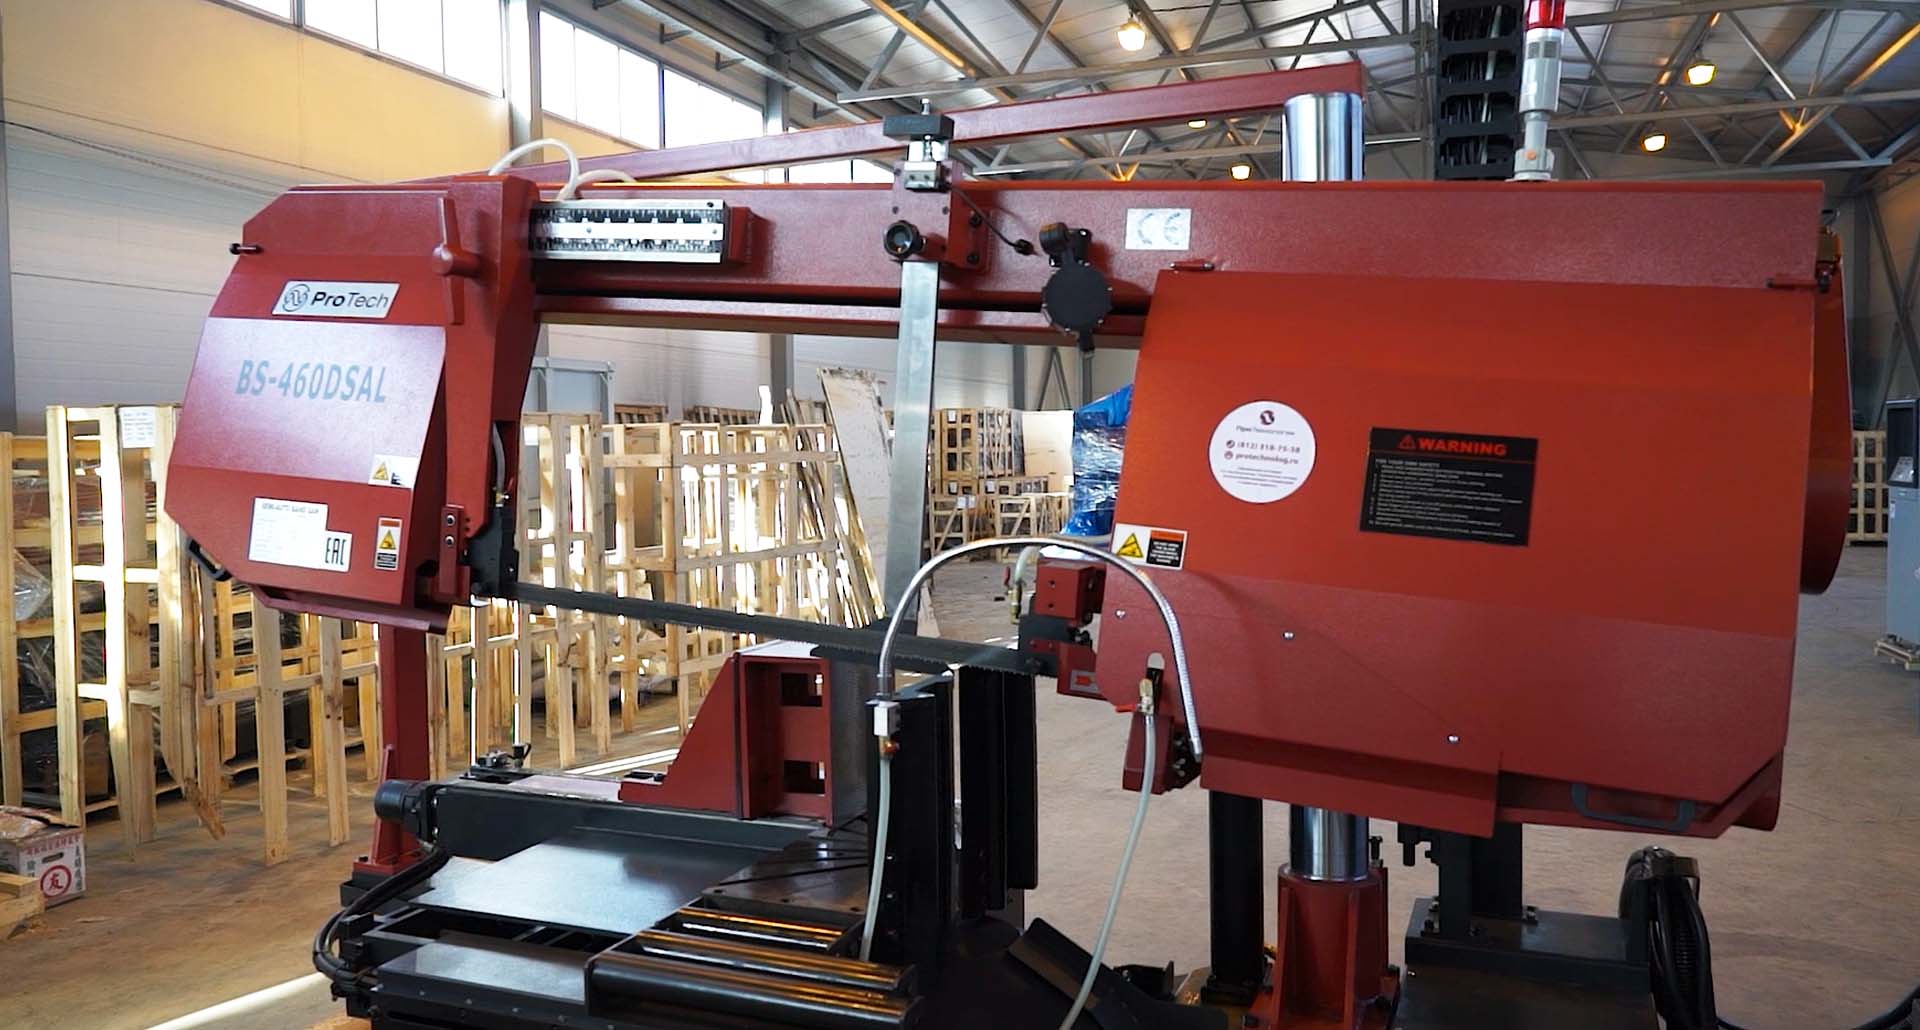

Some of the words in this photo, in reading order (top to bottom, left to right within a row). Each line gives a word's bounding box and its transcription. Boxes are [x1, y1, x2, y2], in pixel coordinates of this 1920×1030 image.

[311, 291, 389, 308] ProTech
[235, 359, 386, 403] BS-460DSAL
[1418, 438, 1507, 456] WARNING
[325, 538, 346, 565] EAC
